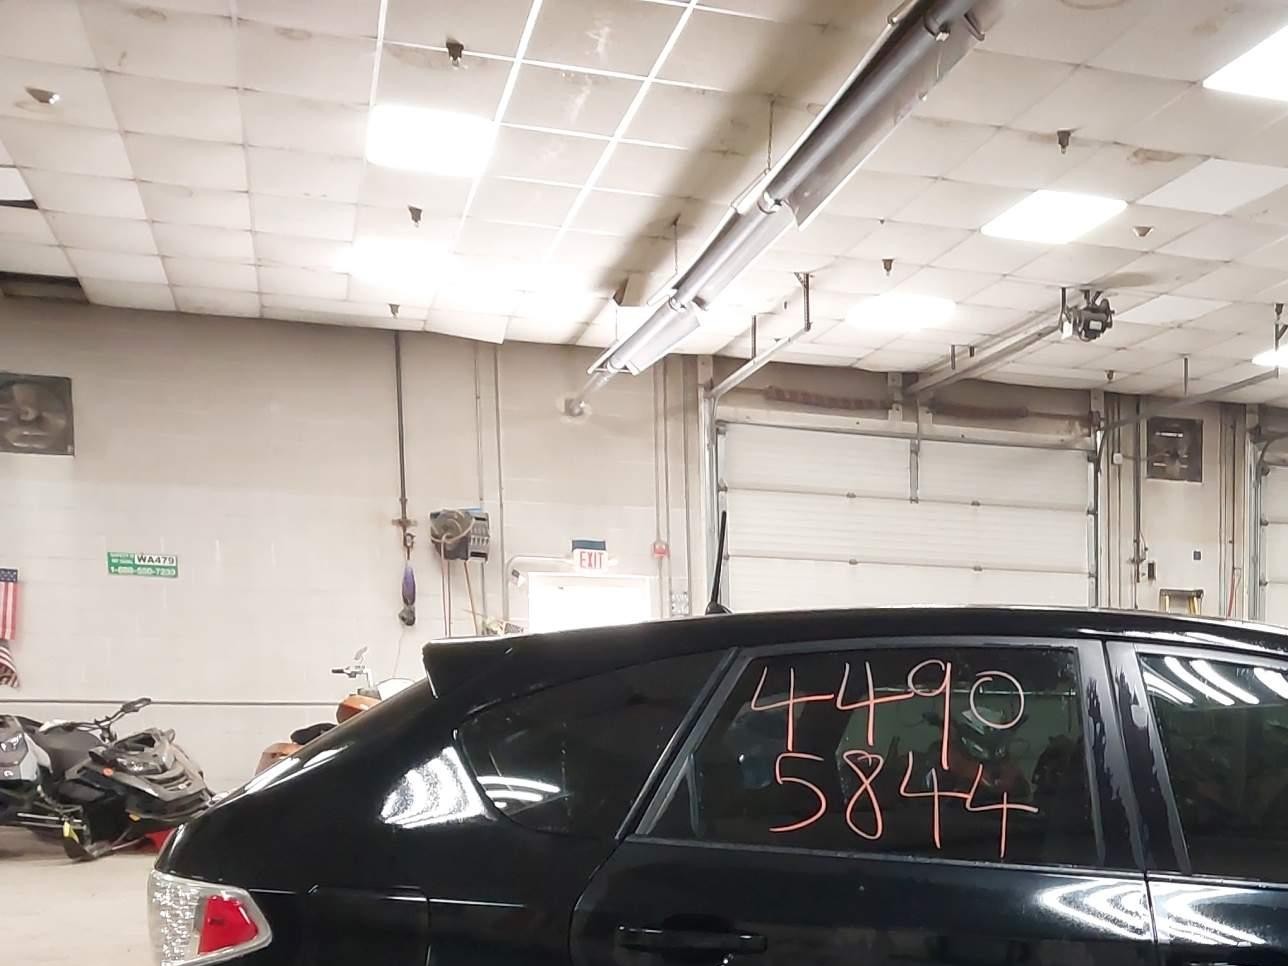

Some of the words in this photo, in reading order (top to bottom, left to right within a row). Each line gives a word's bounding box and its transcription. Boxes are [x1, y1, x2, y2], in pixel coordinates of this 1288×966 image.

[136, 554, 175, 565] WA479
[579, 551, 605, 569] EXIT
[751, 658, 1025, 770] 4490
[768, 749, 1039, 859] 5844
